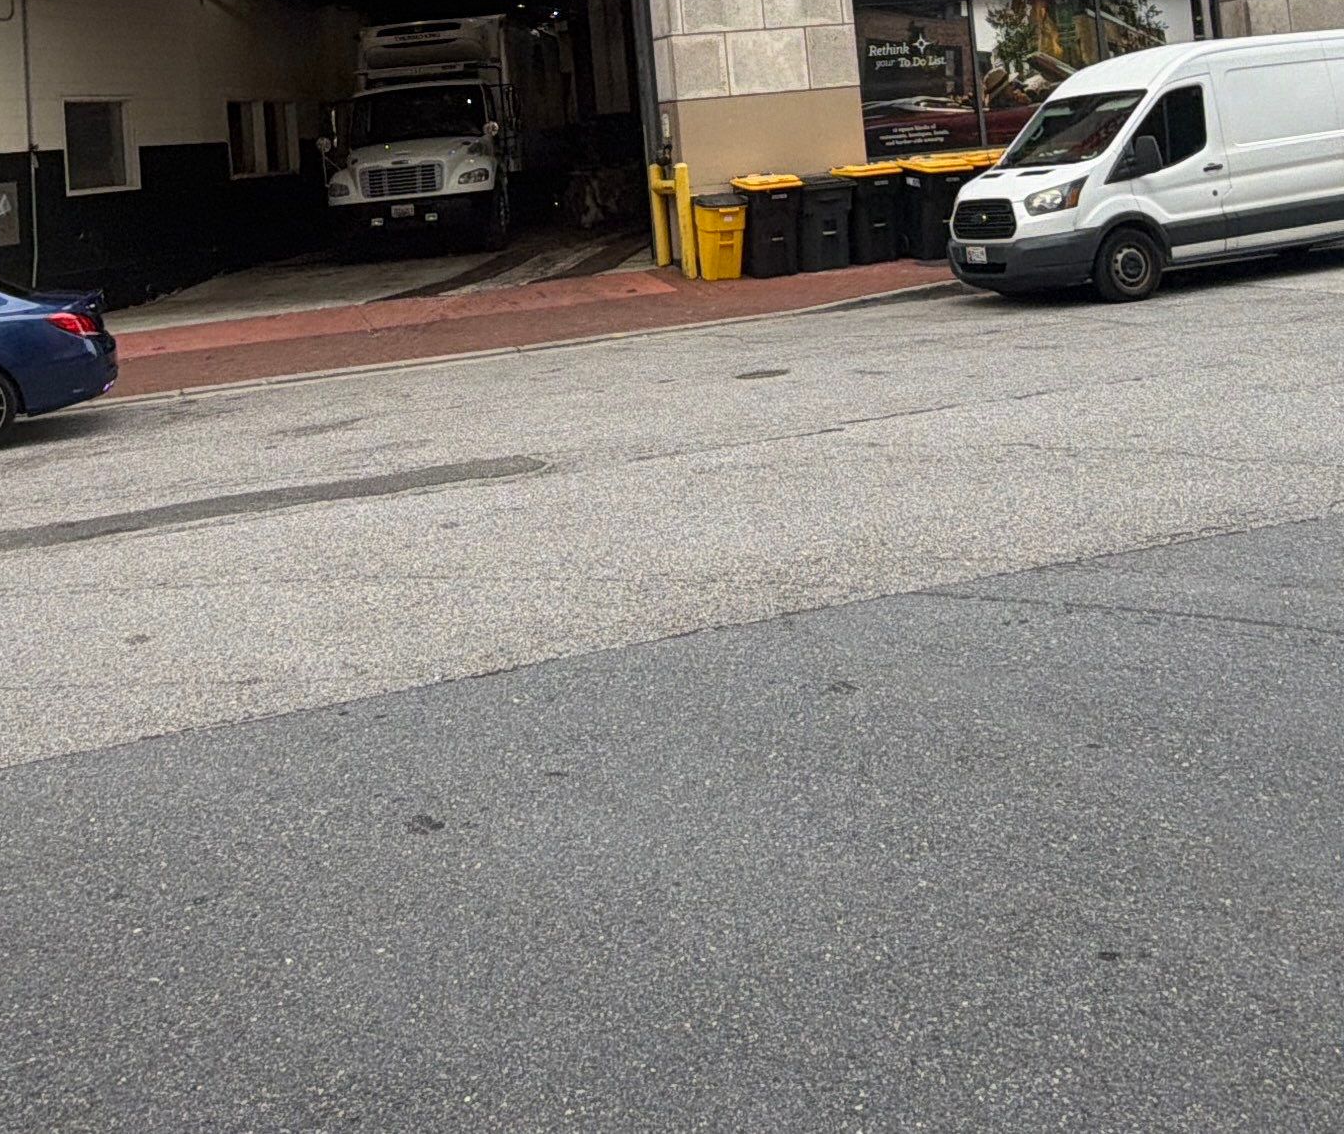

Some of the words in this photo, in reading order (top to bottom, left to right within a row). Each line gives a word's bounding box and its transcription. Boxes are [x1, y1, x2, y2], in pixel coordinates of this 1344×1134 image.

[868, 42, 910, 57] Rethink
[875, 59, 895, 70] your
[898, 57, 911, 68] To
[913, 56, 926, 67] Do
